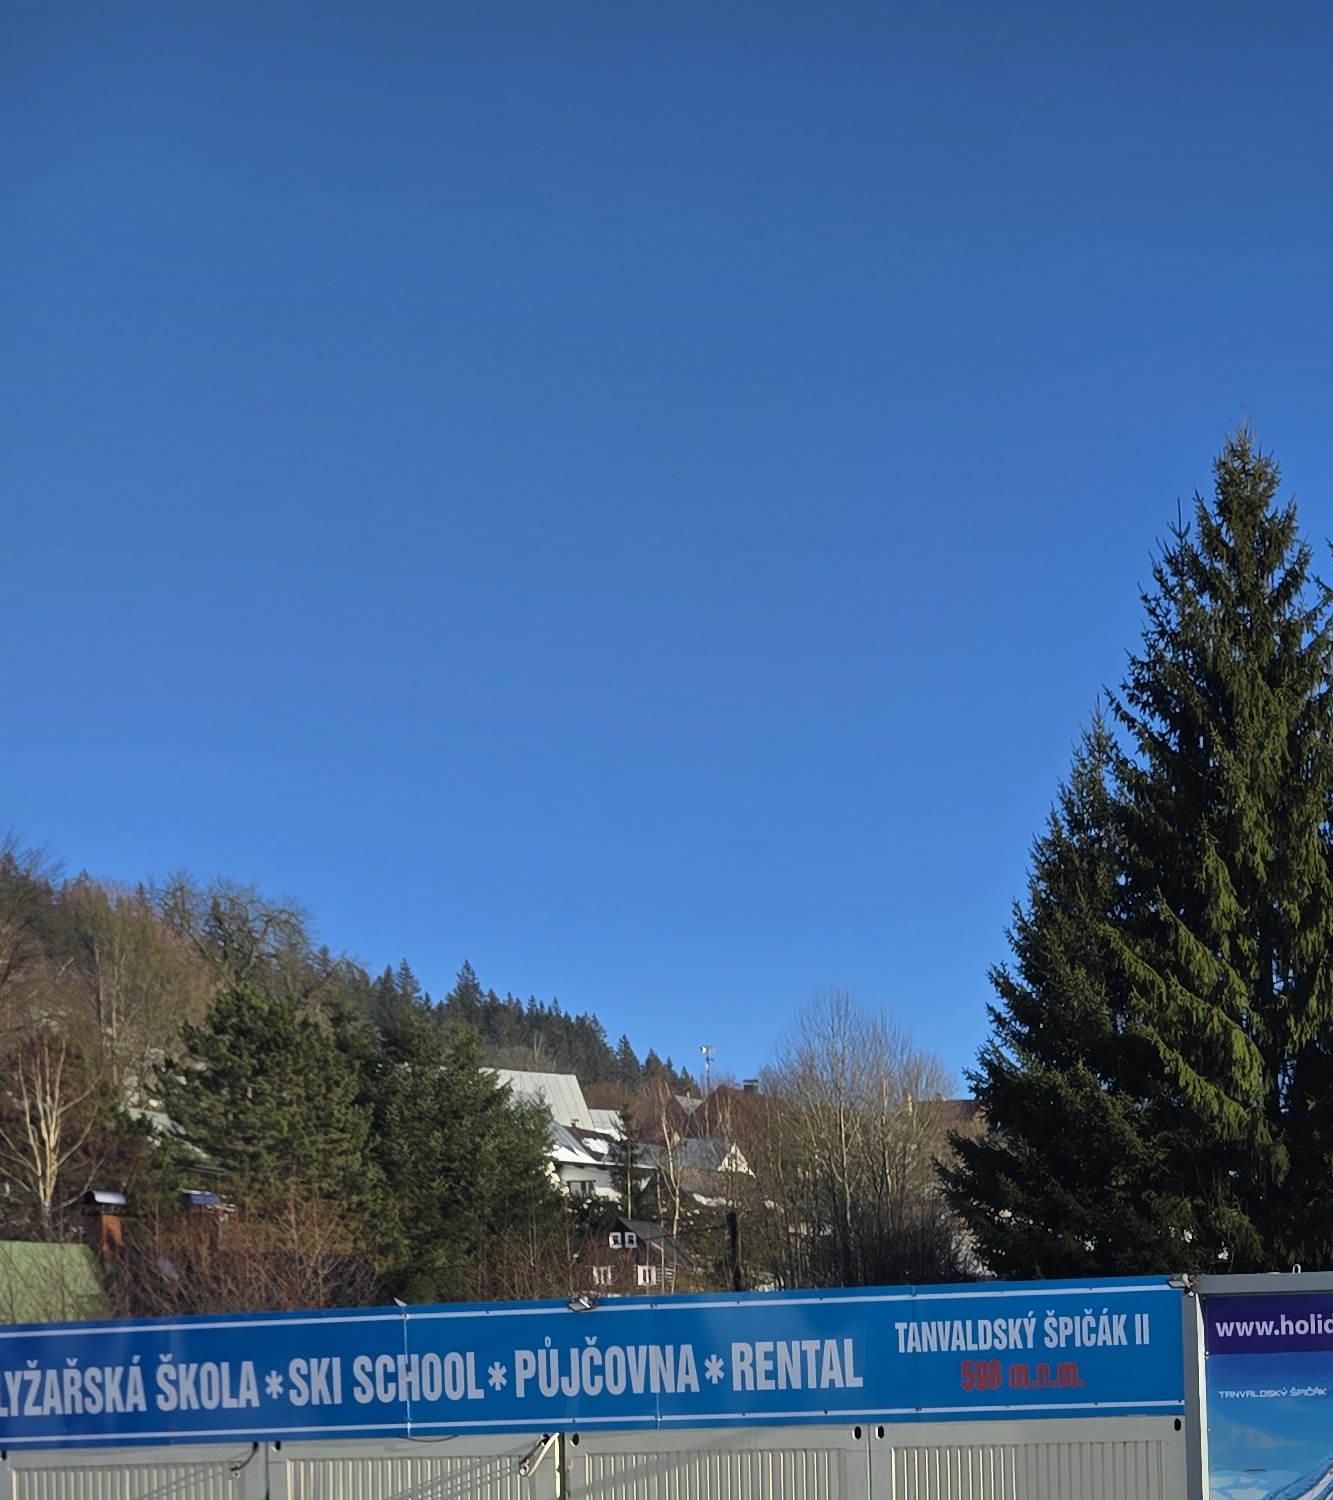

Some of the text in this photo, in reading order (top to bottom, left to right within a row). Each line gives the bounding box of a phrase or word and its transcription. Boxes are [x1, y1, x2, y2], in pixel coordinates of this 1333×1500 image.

[894, 1307, 1150, 1354] TANVALDSKÝ ŠPIČÁK II
[156, 1353, 260, 1412] ŠKOLA
[288, 1357, 343, 1407] SKI
[353, 1351, 485, 1404] SCHOOL
[514, 1335, 701, 1398] PŮJČOVNA
[731, 1339, 864, 1391] RENTAL
[960, 1359, 1085, 1391] 598 m.n.m.
[1218, 1386, 1327, 1398] TANVALDSKÝ ŠPIČÁK
